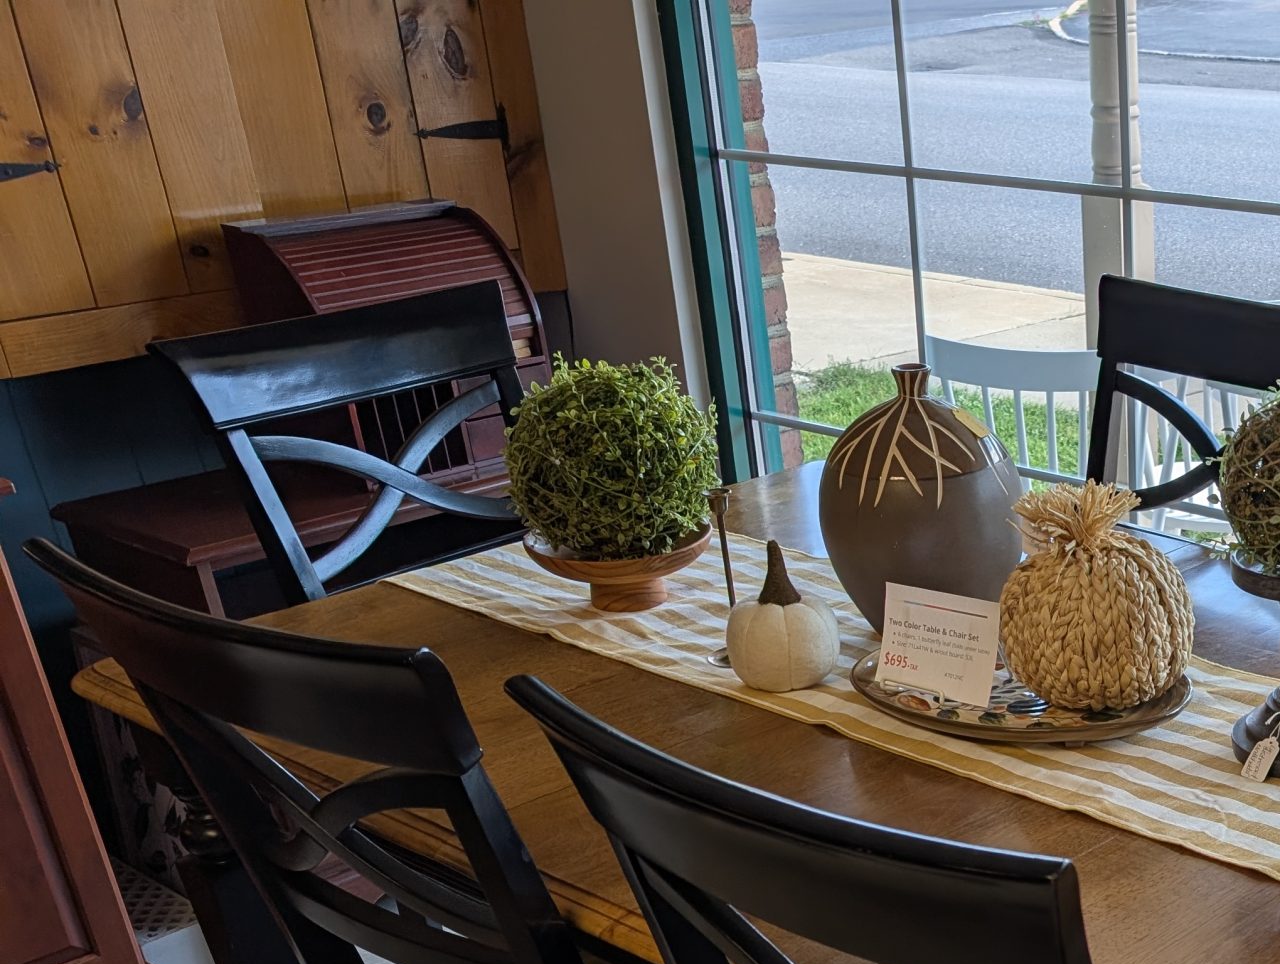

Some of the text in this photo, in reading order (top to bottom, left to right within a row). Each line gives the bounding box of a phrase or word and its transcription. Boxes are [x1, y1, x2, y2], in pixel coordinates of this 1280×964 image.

[889, 617, 979, 642] Two Color Table & Chair Set
